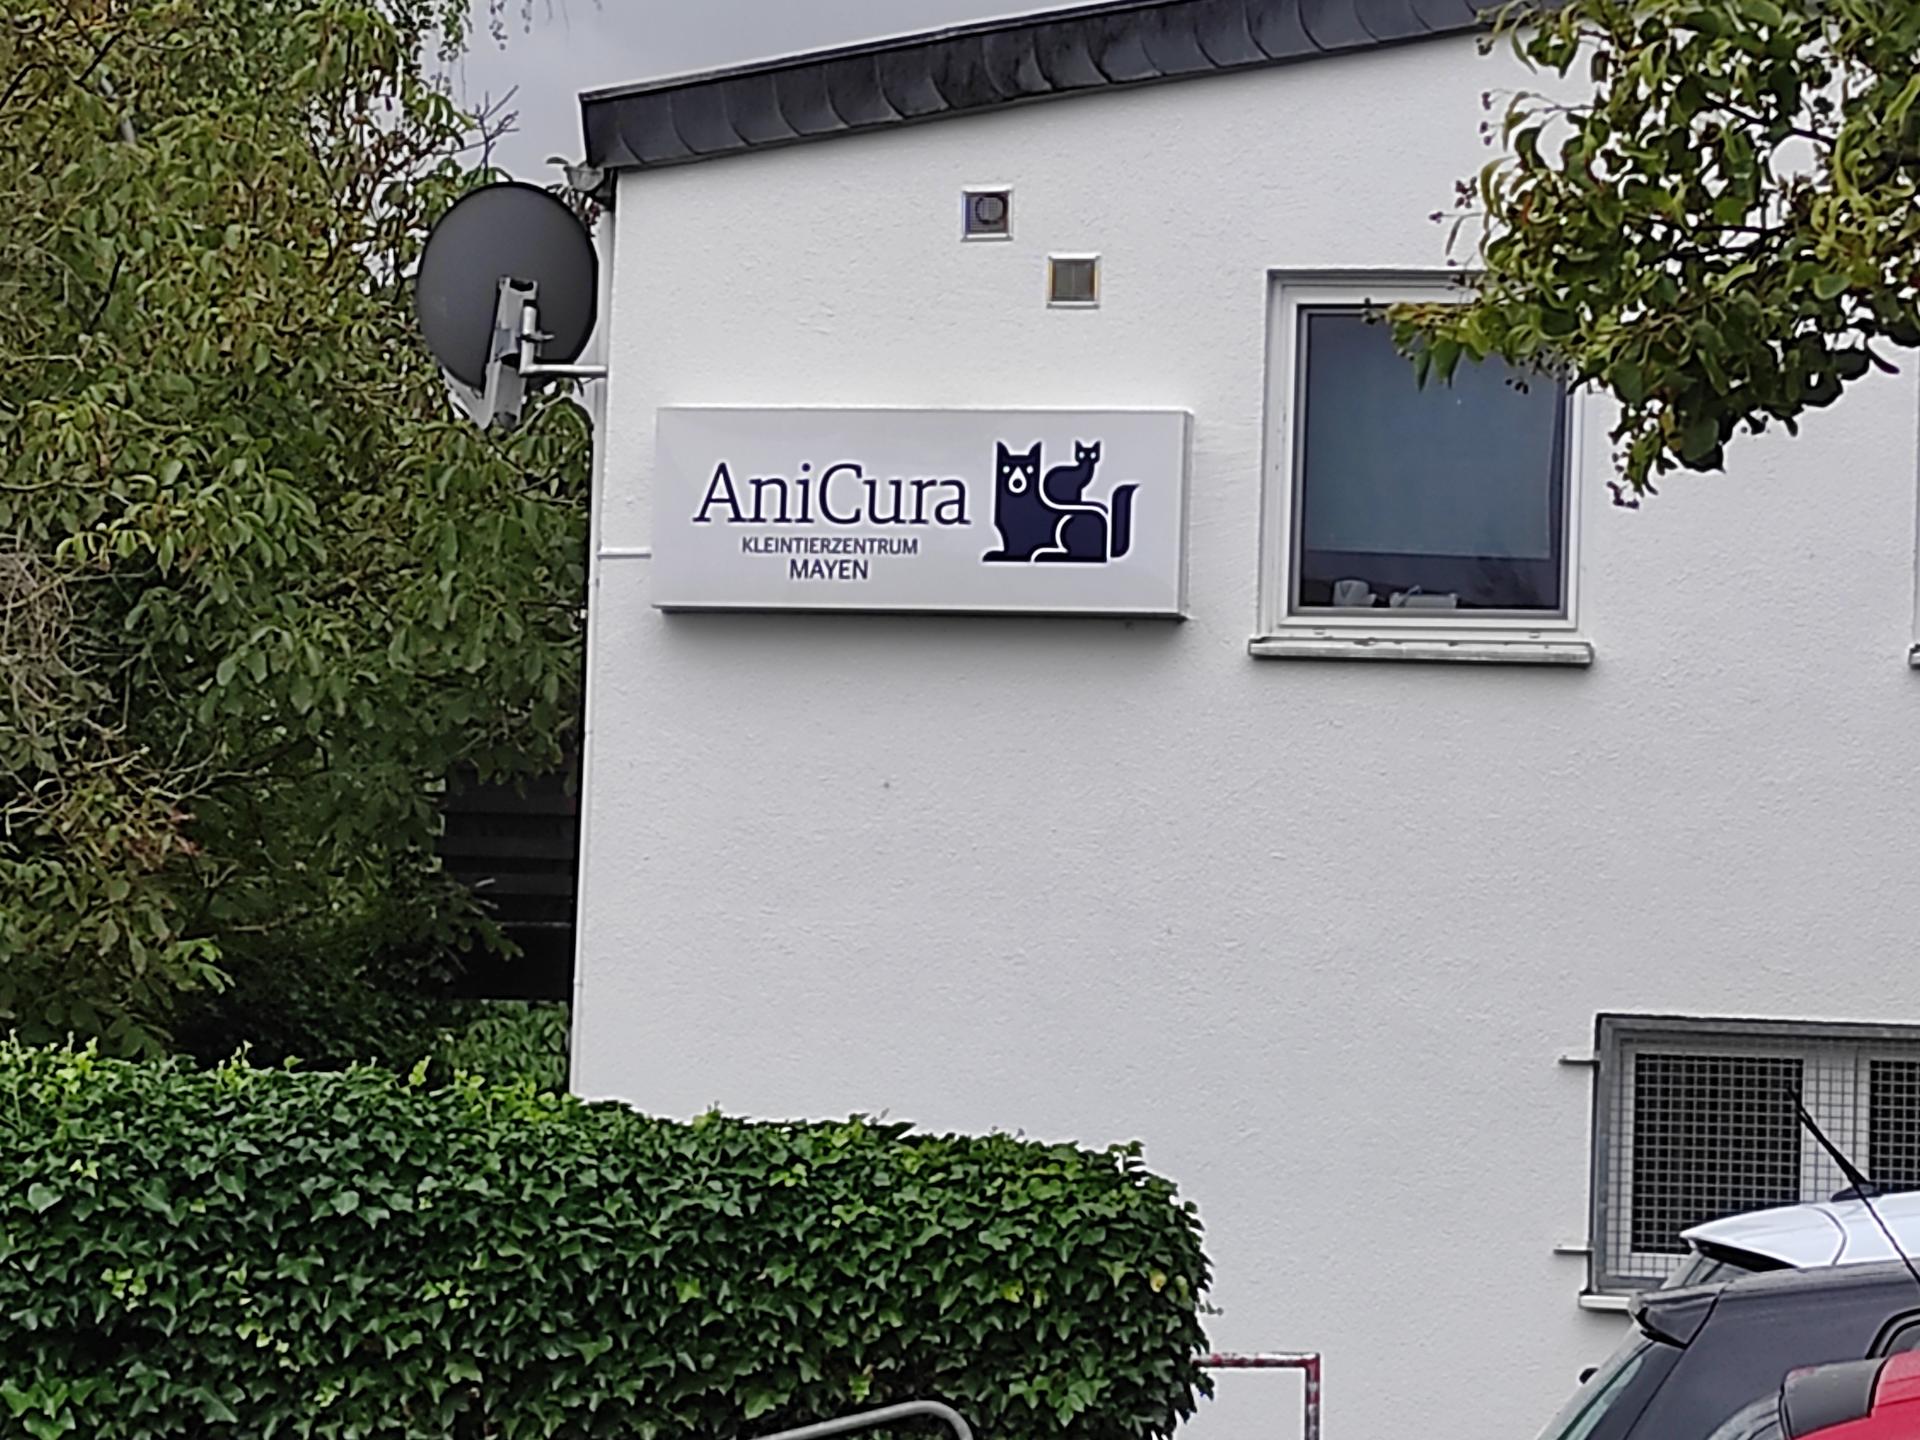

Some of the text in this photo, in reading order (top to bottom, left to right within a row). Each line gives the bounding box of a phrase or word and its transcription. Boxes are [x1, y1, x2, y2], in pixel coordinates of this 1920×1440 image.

[692, 462, 971, 525] AniCura
[742, 537, 918, 555] KLEINTIERZENTRUM
[789, 558, 869, 580] MAYEN
